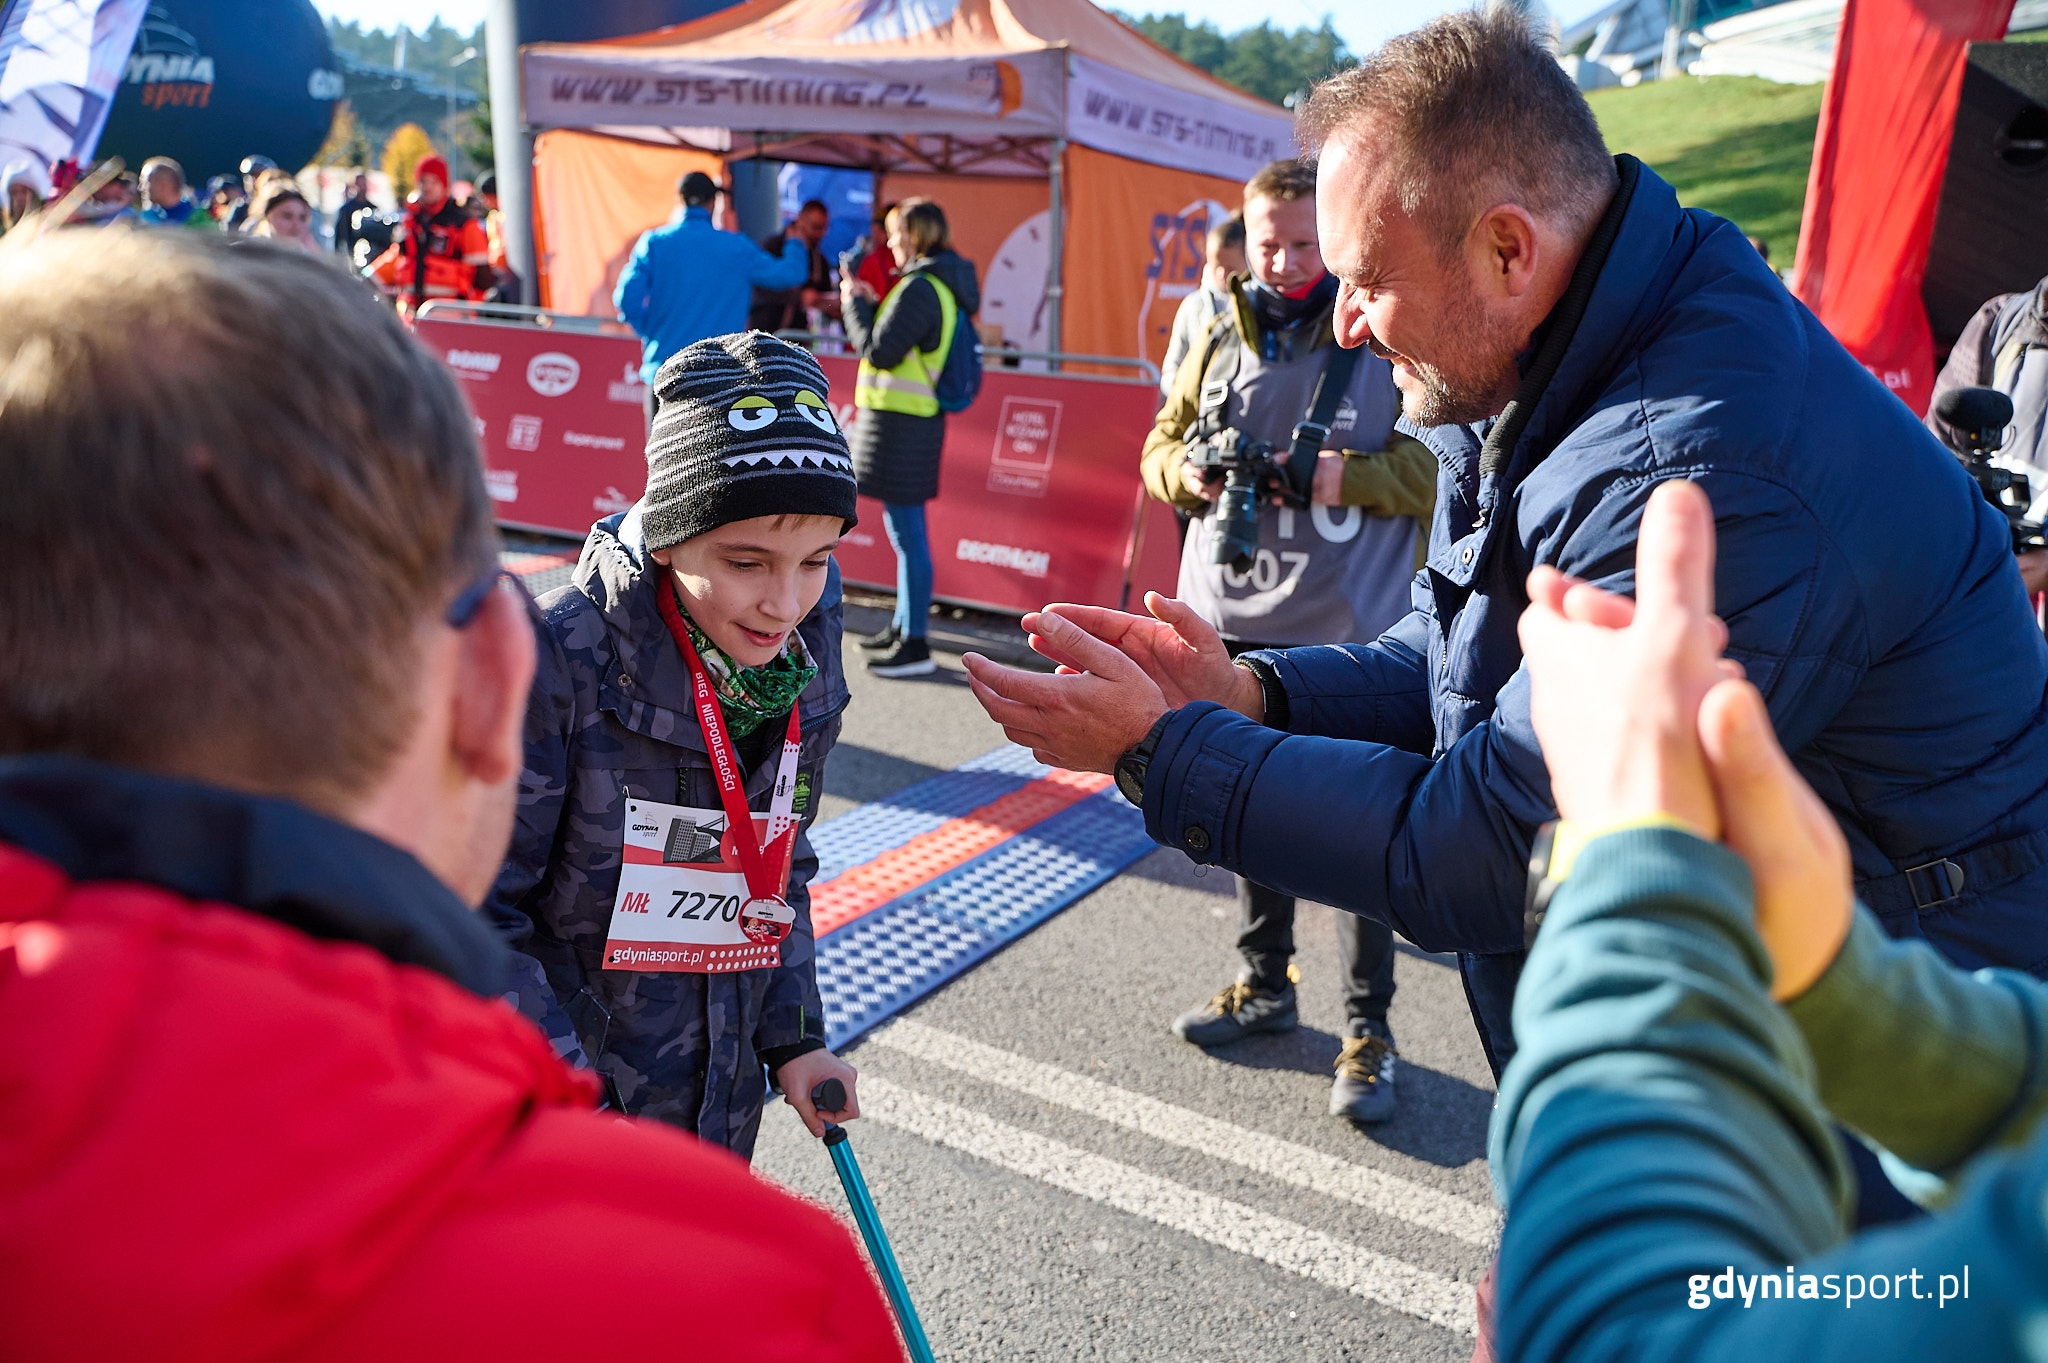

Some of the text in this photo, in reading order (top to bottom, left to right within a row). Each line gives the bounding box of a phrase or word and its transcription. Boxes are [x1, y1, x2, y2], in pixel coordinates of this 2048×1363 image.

[142, 83, 213, 110] sport
[1146, 213, 1204, 279] STS
[956, 538, 1050, 574] DECATHLON
[695, 671, 736, 791] BIEG NIEPODLEGŁOŚCI
[631, 823, 659, 832] GDYNIA
[620, 891, 650, 914] MŁ
[666, 890, 741, 923] 7270
[613, 947, 704, 966] gdyniasport.pl
